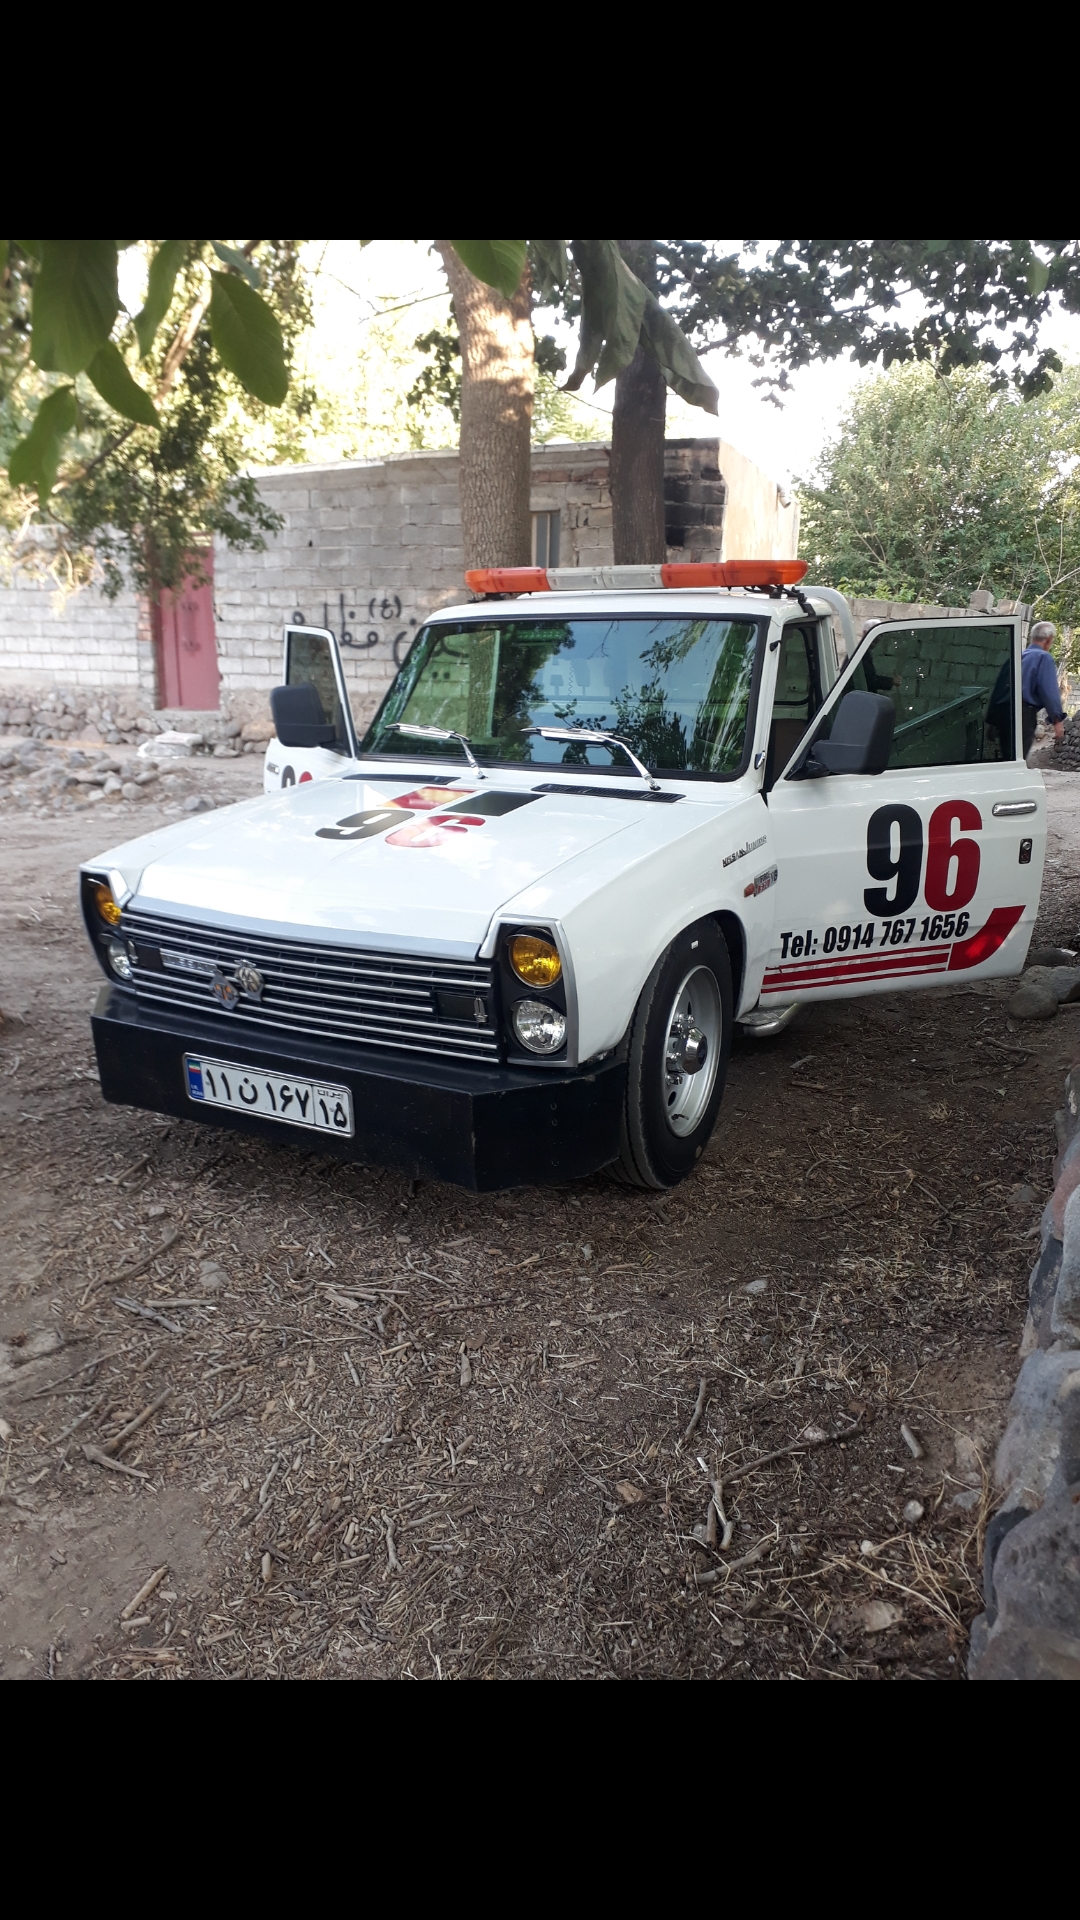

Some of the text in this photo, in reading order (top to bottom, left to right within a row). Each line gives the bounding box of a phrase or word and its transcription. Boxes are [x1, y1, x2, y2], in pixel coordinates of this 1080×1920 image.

[315, 809, 485, 848] 96
[864, 800, 983, 917] 96
[780, 911, 970, 959] Tel: 0914 767 1656
